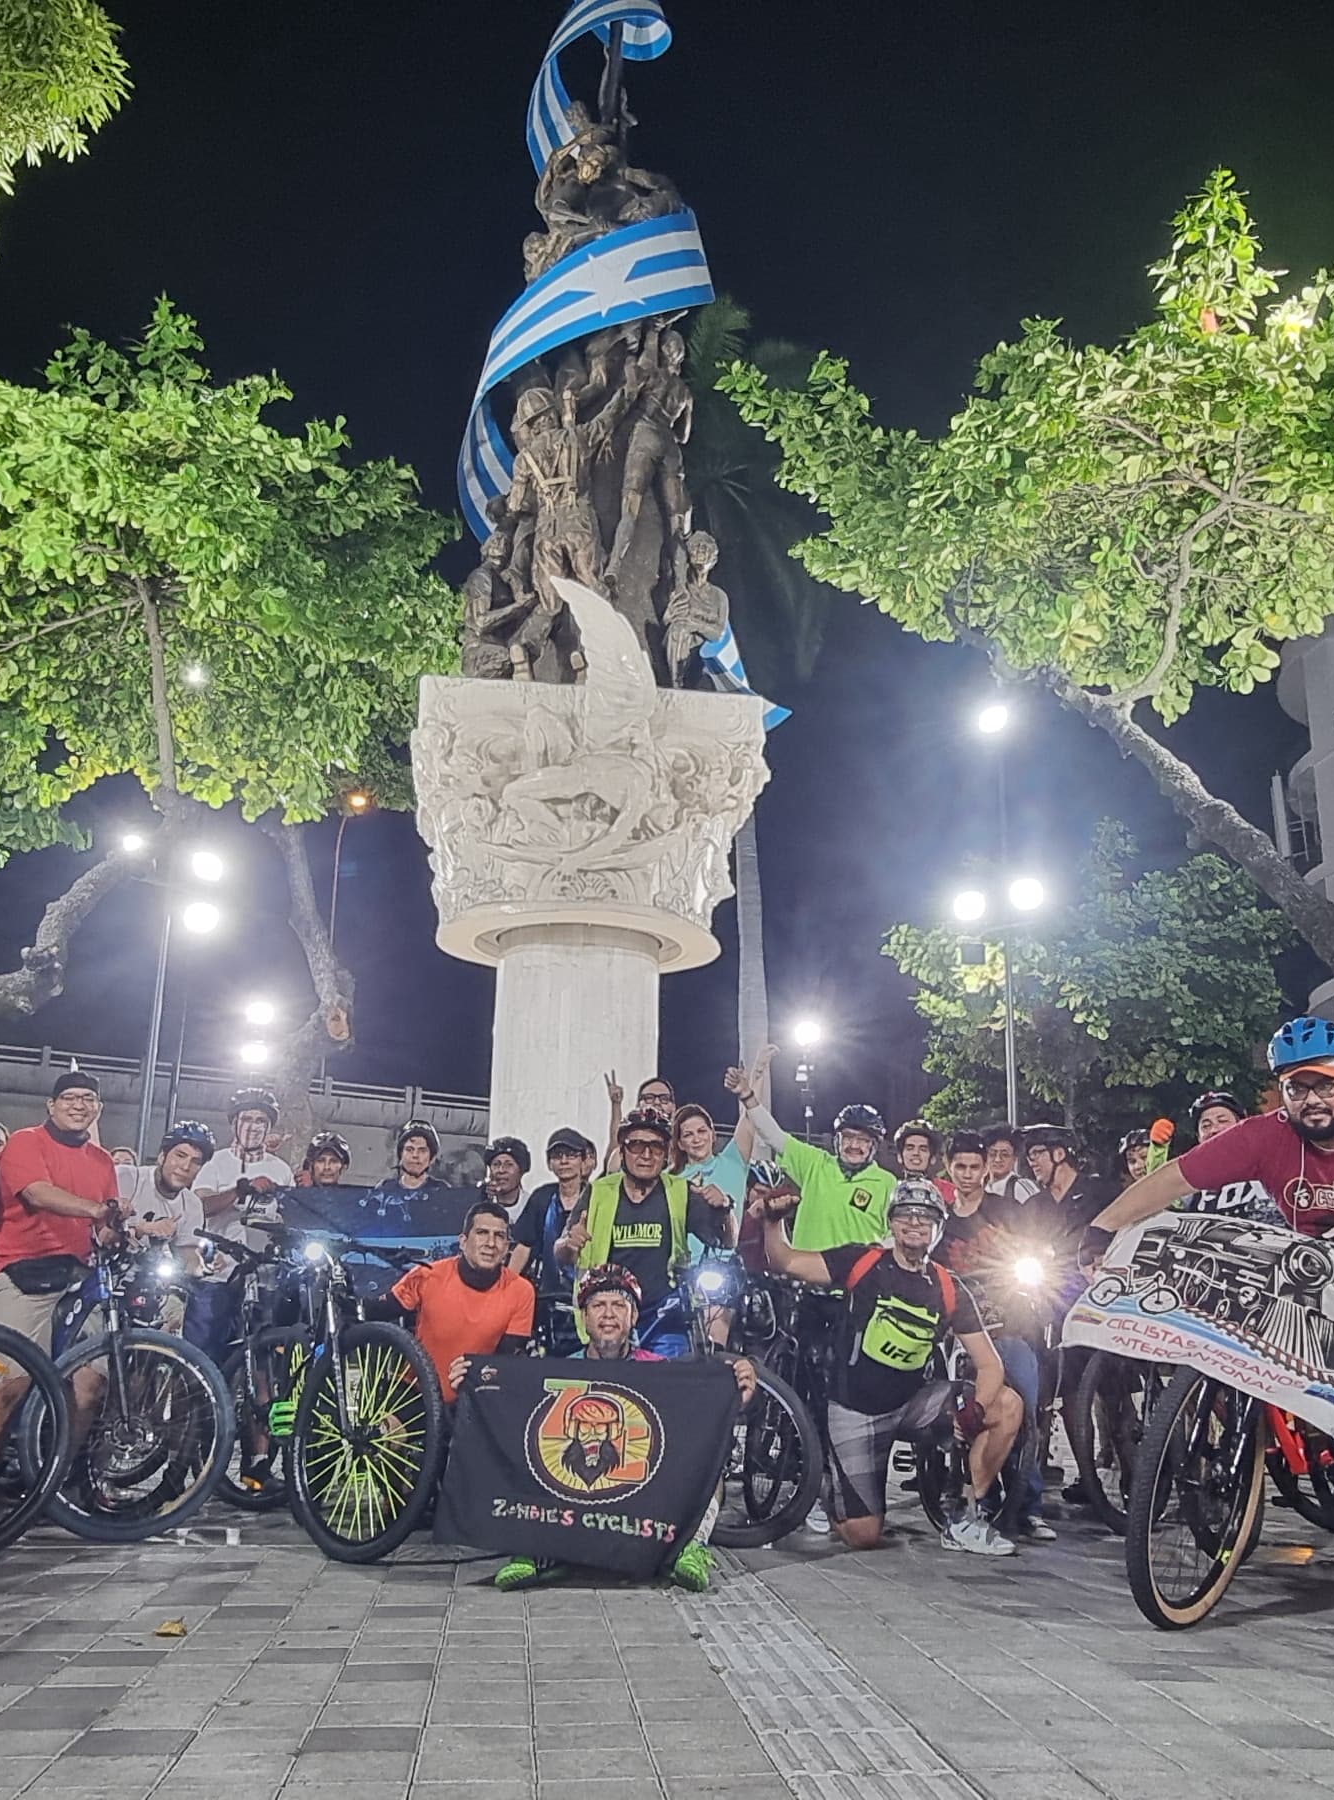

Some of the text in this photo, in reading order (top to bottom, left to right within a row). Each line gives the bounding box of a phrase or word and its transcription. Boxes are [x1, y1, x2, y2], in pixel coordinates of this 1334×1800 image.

[1197, 1180, 1269, 1211] FOX
[880, 1341, 917, 1364] UFC
[1106, 1318, 1306, 1389] CICLISTAS URBANOS
[1111, 1335, 1276, 1394] INTERCANTONAL
[582, 1512, 677, 1542] CYCLISTS
